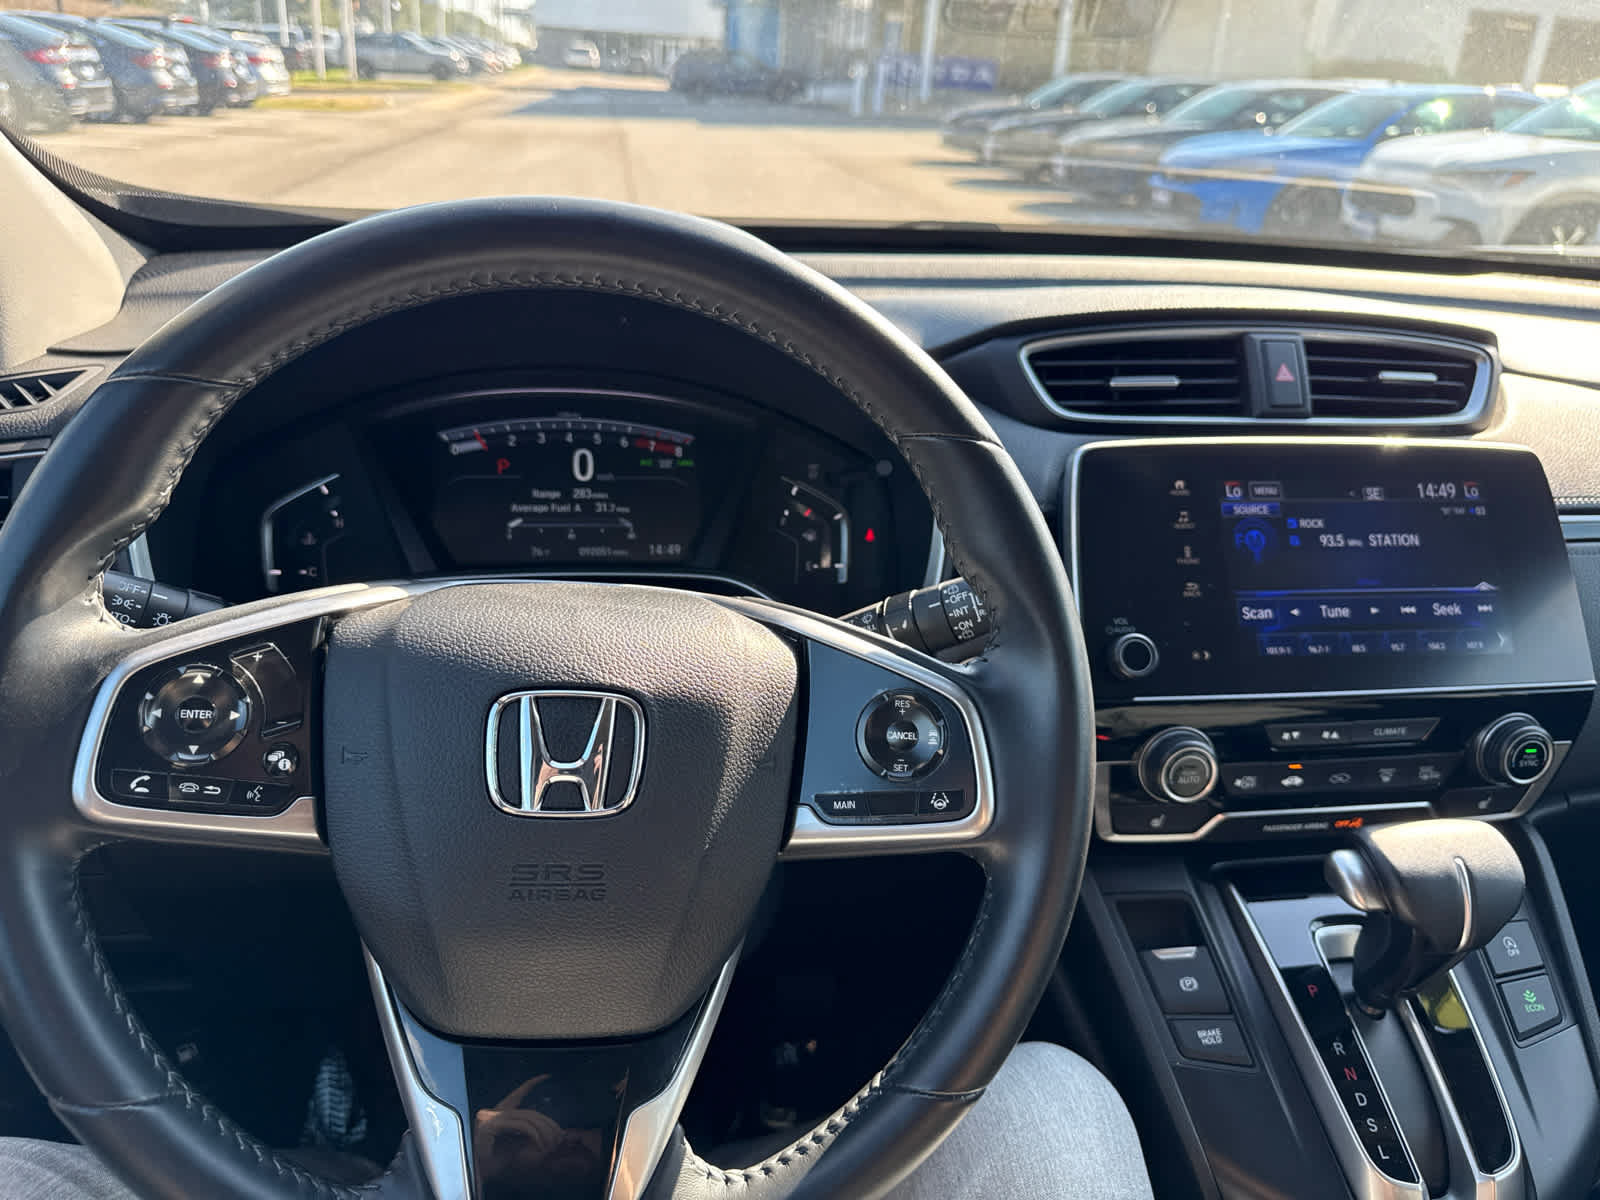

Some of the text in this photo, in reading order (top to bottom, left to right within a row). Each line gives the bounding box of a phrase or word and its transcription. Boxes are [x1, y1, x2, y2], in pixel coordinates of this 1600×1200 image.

[507, 434, 518, 448] 2
[537, 431, 547, 445] 3
[565, 431, 574, 443] 4
[592, 432, 602, 445] 5
[619, 435, 629, 449] 6
[648, 440, 657, 453] 7
[674, 446, 684, 458] 8
[496, 457, 511, 475] P
[572, 448, 595, 482] 0
[1224, 484, 1243, 498] Lo
[1416, 482, 1457, 499] 14:49
[1463, 485, 1480, 498] Lo
[511, 503, 549, 515] Average
[1232, 504, 1270, 515] SOURCE
[1319, 534, 1345, 547] 93.5
[1368, 533, 1421, 547] STATION
[119, 582, 142, 594] OFF
[949, 591, 969, 605] OFF
[952, 605, 970, 618] INT
[1242, 602, 1462, 620] Scan Tune Seek
[957, 619, 974, 632] ON
[894, 700, 911, 709] RES
[180, 709, 213, 719] ENTER
[886, 731, 918, 741] CANCEL
[1373, 727, 1407, 736] CLIMATE
[893, 763, 909, 772] SET
[1177, 775, 1200, 784] AUTO
[833, 800, 856, 810] MAIN
[510, 862, 605, 881] SRS
[507, 888, 607, 901] AIRBAG
[1306, 984, 1319, 998] P
[1197, 1028, 1222, 1038] BRAKE
[1201, 1036, 1223, 1045] HOLD
[1332, 1041, 1346, 1056] R
[1343, 1066, 1358, 1081] N
[1355, 1092, 1368, 1107] D
[1366, 1118, 1379, 1133] S
[1377, 1144, 1390, 1160] L
